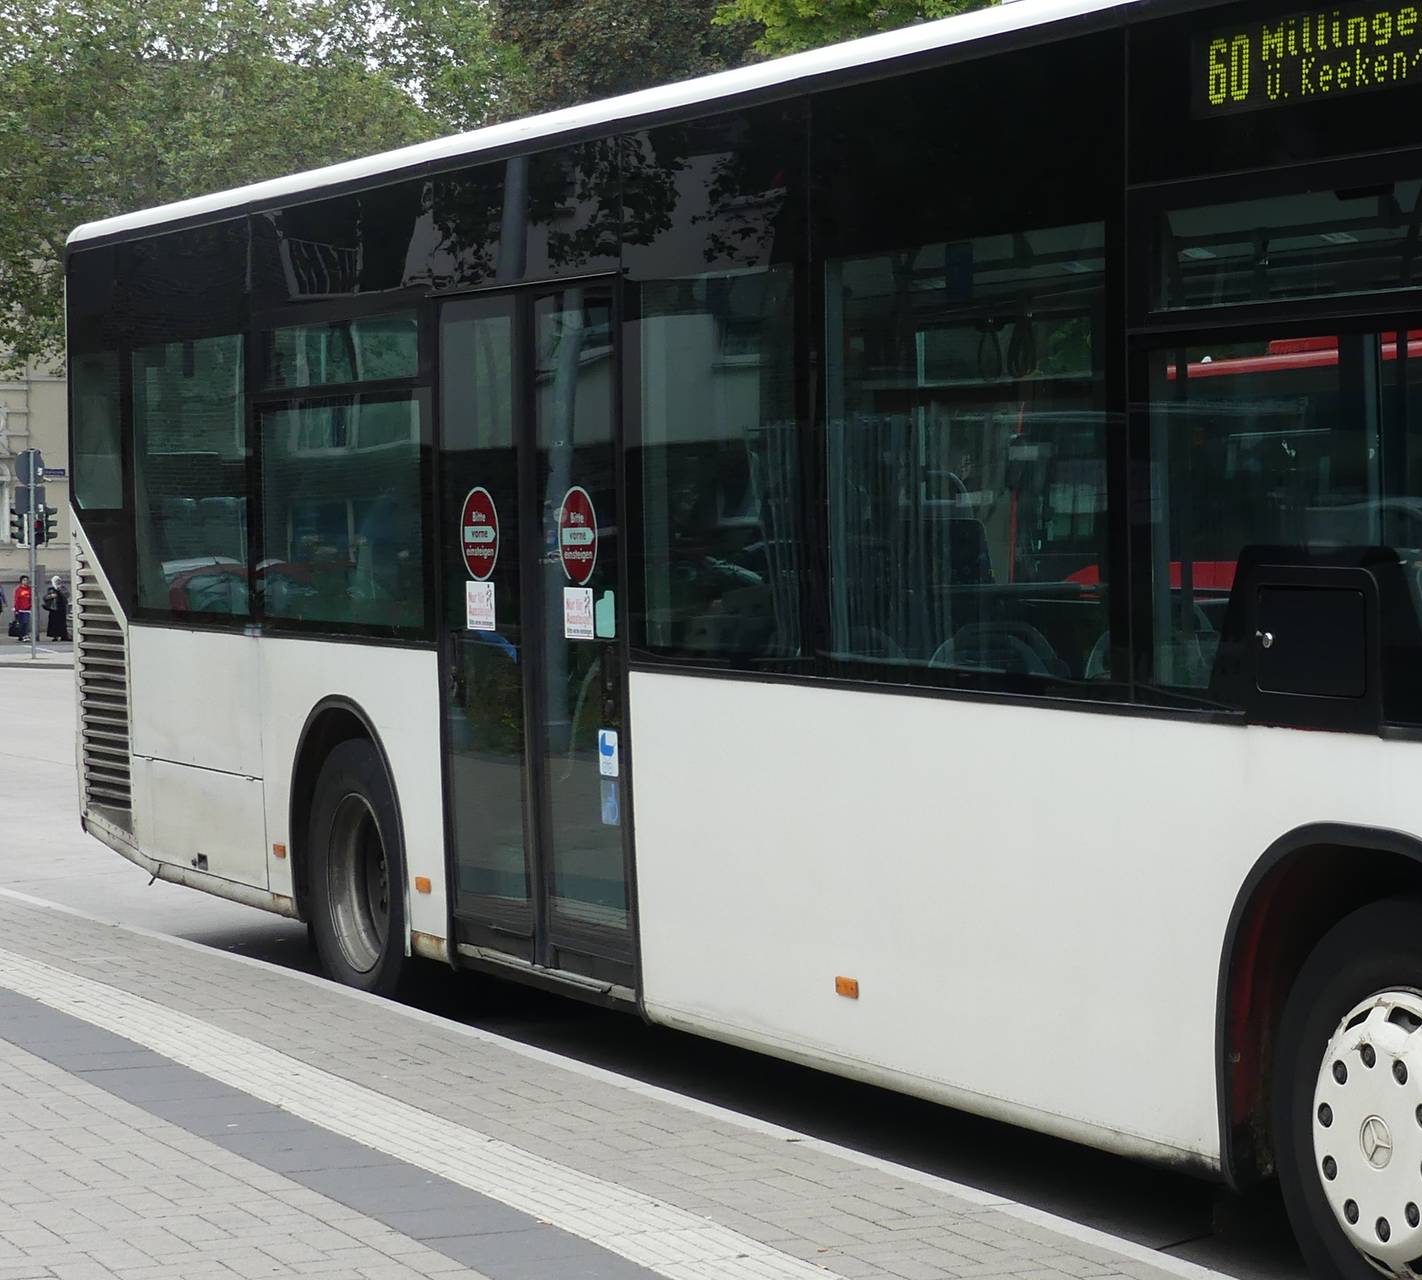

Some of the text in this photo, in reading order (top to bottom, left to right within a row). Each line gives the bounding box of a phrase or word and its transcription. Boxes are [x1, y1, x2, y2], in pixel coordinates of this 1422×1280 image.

[1209, 34, 1250, 104] 60
[471, 530, 488, 538] vorne
[569, 532, 586, 541] vorne
